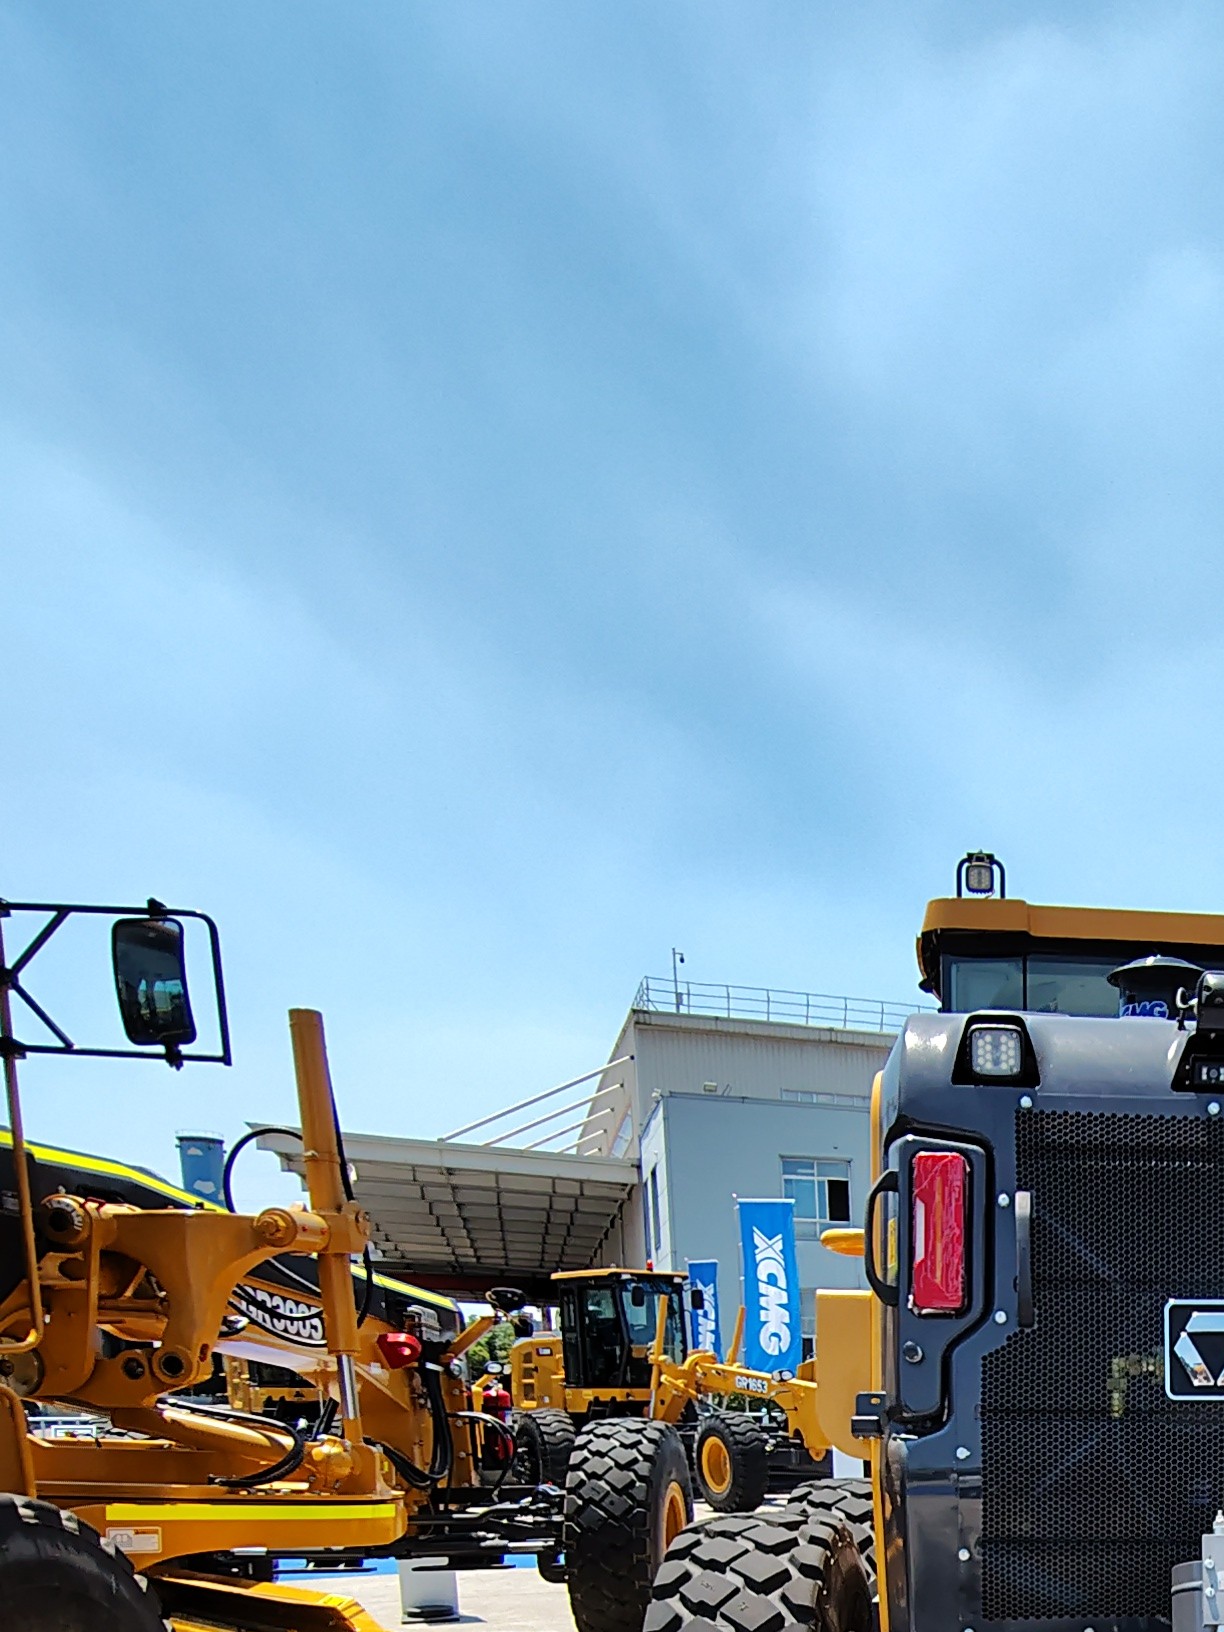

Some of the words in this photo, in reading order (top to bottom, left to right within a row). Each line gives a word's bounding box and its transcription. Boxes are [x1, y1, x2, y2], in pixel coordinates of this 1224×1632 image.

[696, 1278, 716, 1353] XCM
[752, 1225, 791, 1356] XCMG
[735, 1375, 769, 1394] GR1653
